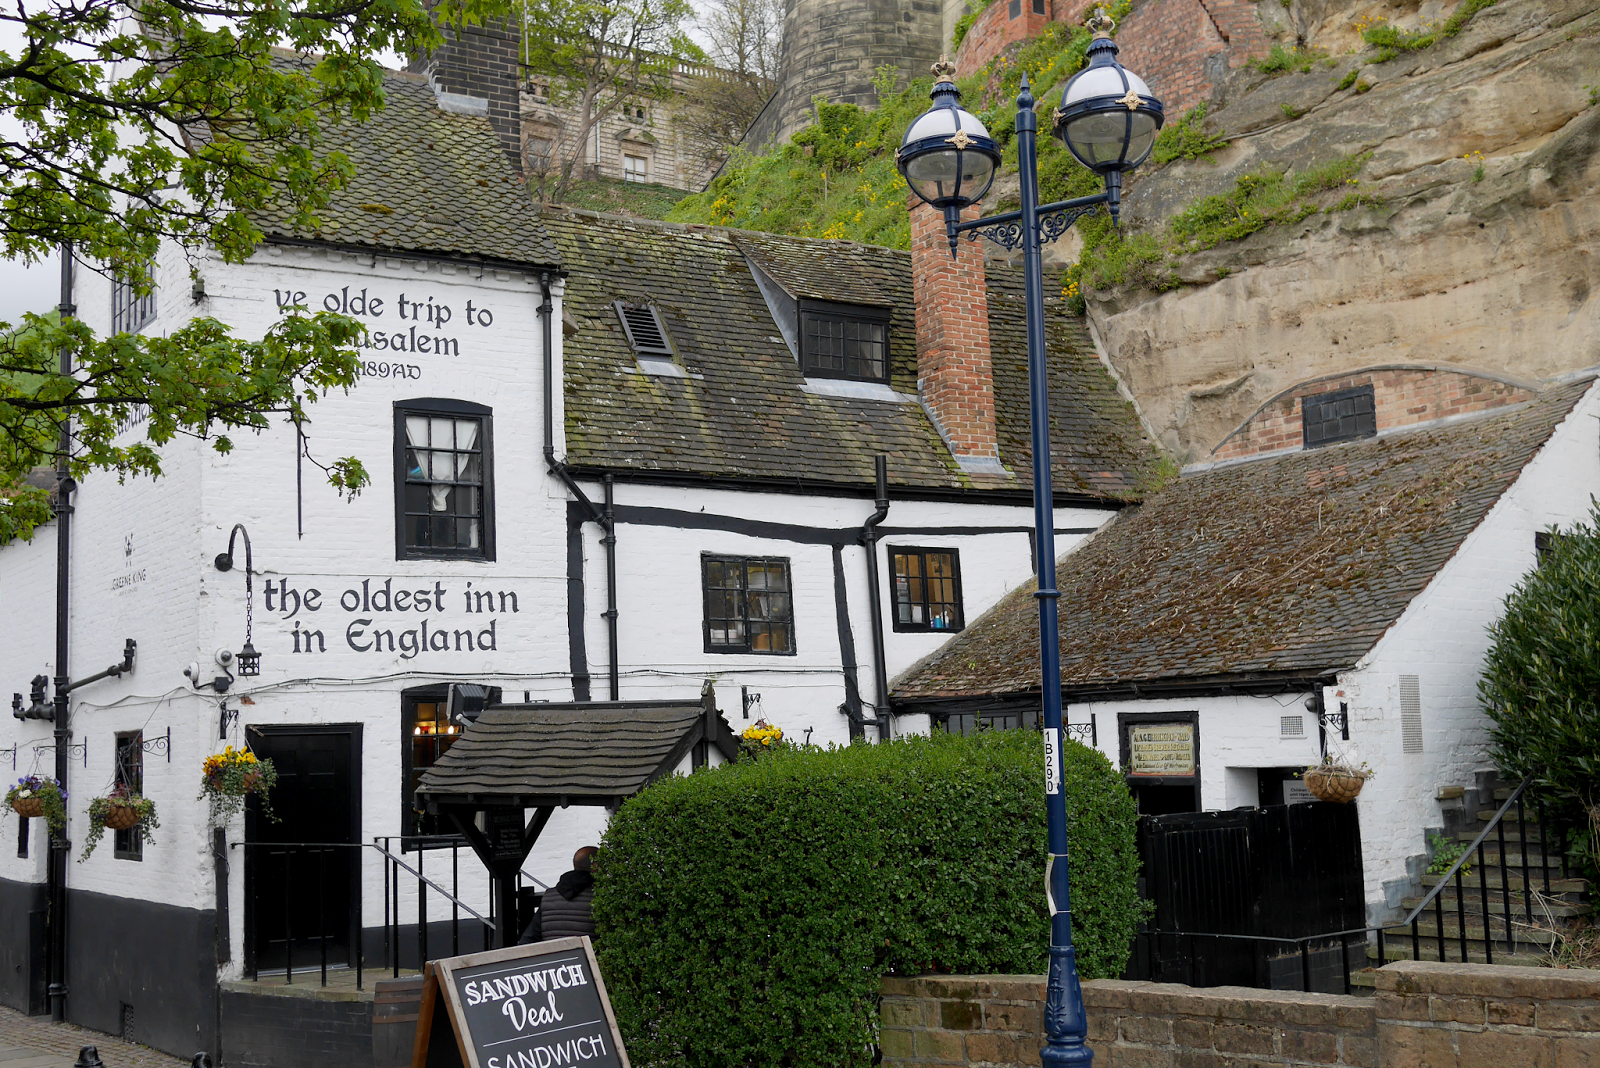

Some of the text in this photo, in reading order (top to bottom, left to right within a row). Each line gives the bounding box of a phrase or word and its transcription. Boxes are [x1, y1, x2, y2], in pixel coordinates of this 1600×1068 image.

[272, 286, 493, 329] ye olde trip to
[132, 569, 146, 584] KING
[263, 577, 519, 620] the oldest inn
[291, 618, 497, 659] in England
[464, 964, 588, 1006] SANDWICH
[502, 990, 564, 1031] Deal
